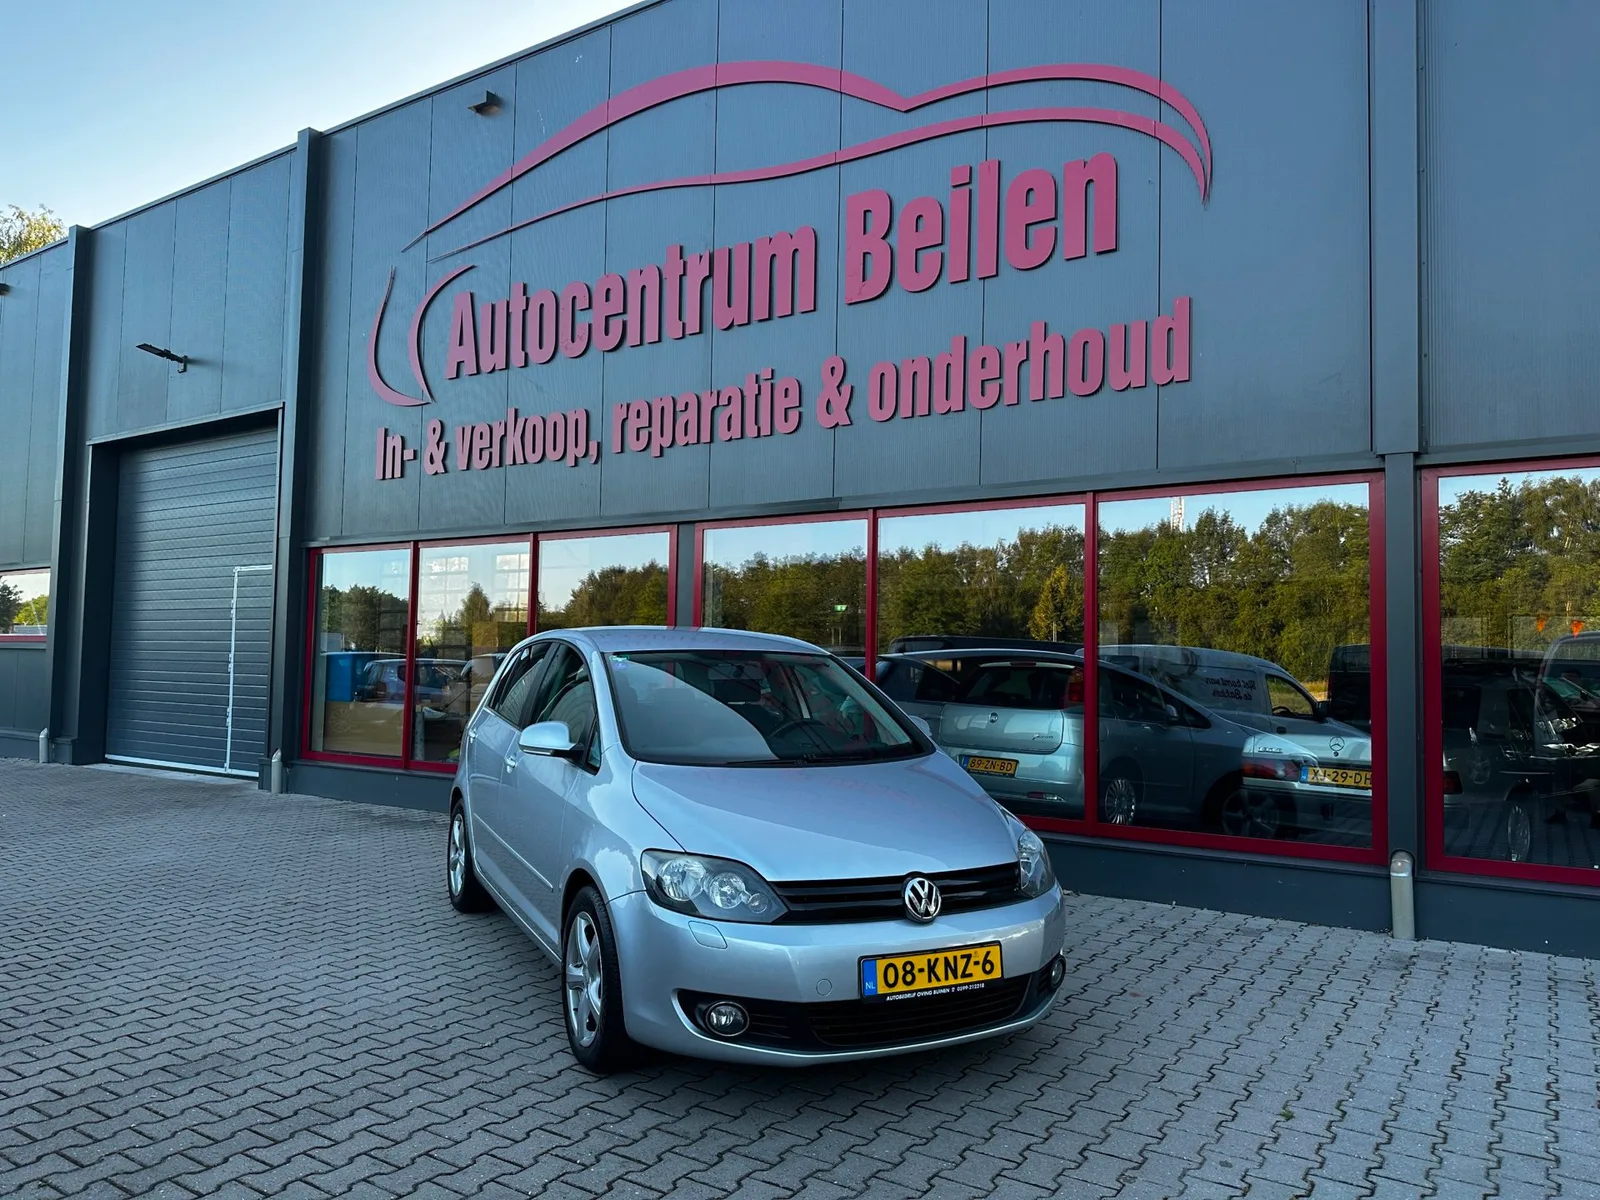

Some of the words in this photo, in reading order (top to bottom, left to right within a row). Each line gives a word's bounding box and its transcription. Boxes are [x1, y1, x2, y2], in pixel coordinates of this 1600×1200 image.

[445, 225, 818, 379] Autocentrum
[845, 152, 1118, 304] Beilen
[375, 427, 416, 480] In-
[423, 418, 447, 475] &
[455, 407, 600, 467] verkoop,
[612, 367, 801, 457] reparatie
[816, 355, 853, 429] &
[868, 296, 1192, 422] onderhoud
[969, 758, 1013, 772] 89-ZN-BD
[882, 950, 996, 989] 08-KNZ-6
[865, 981, 876, 990] NL
[885, 992, 916, 1001] AUTOBEDRIJF
